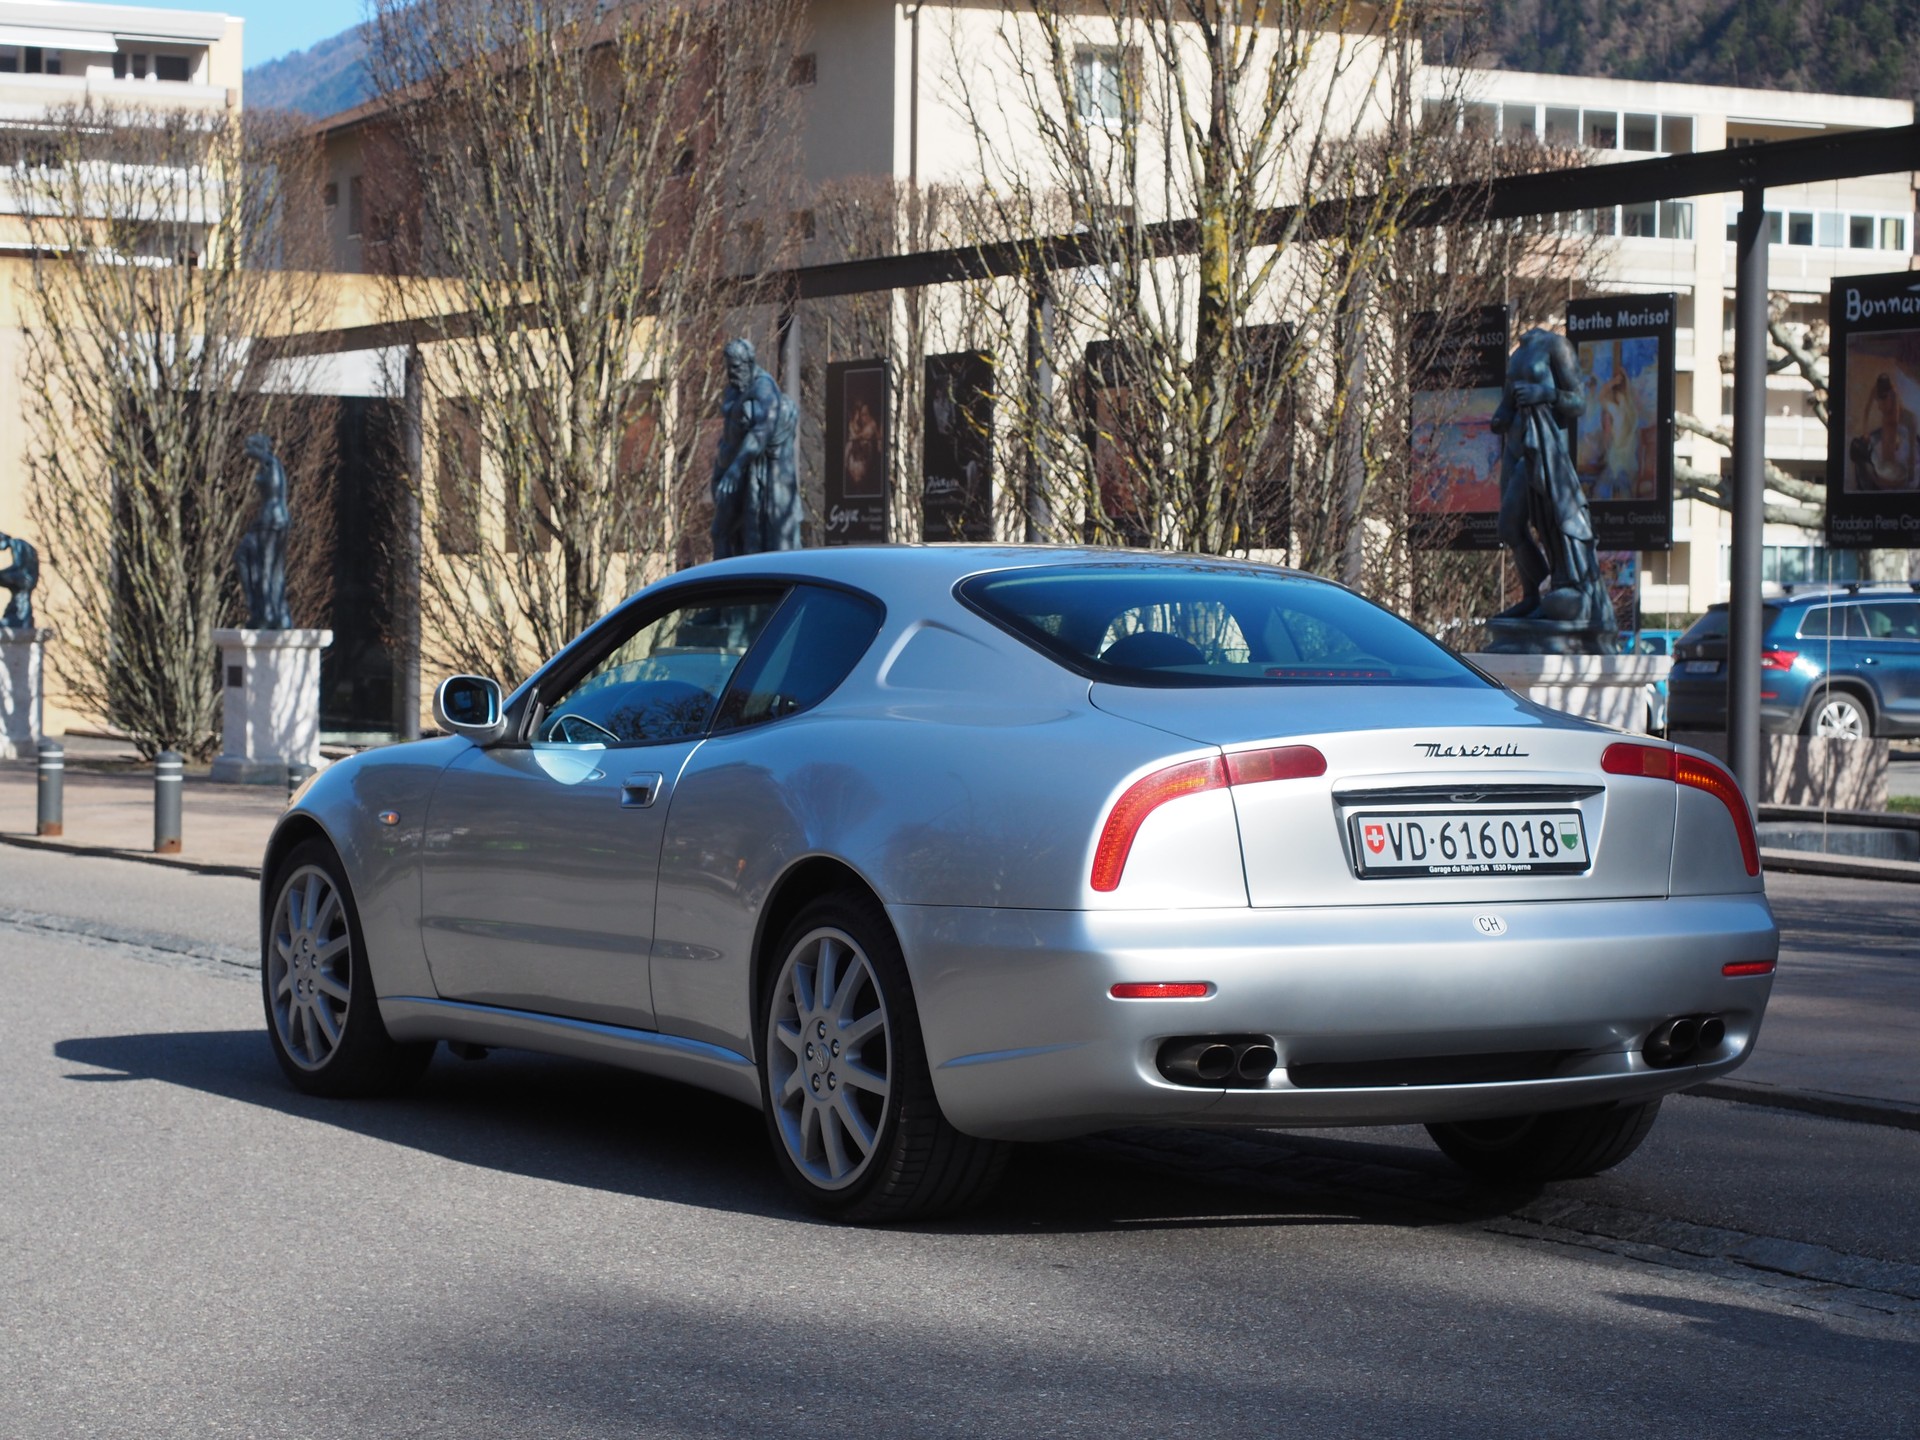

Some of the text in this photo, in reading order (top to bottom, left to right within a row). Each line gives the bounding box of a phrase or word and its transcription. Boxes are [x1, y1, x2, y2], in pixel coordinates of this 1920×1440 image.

[1846, 284, 1920, 322] Bonnar
[1569, 307, 1670, 331] Berthe Morisot
[1831, 514, 1874, 530] Fondation
[1413, 742, 1530, 758] Maserati
[1429, 863, 1532, 875] Garage du Rallye SA 1530 Payerne
[1479, 917, 1500, 931] CH
